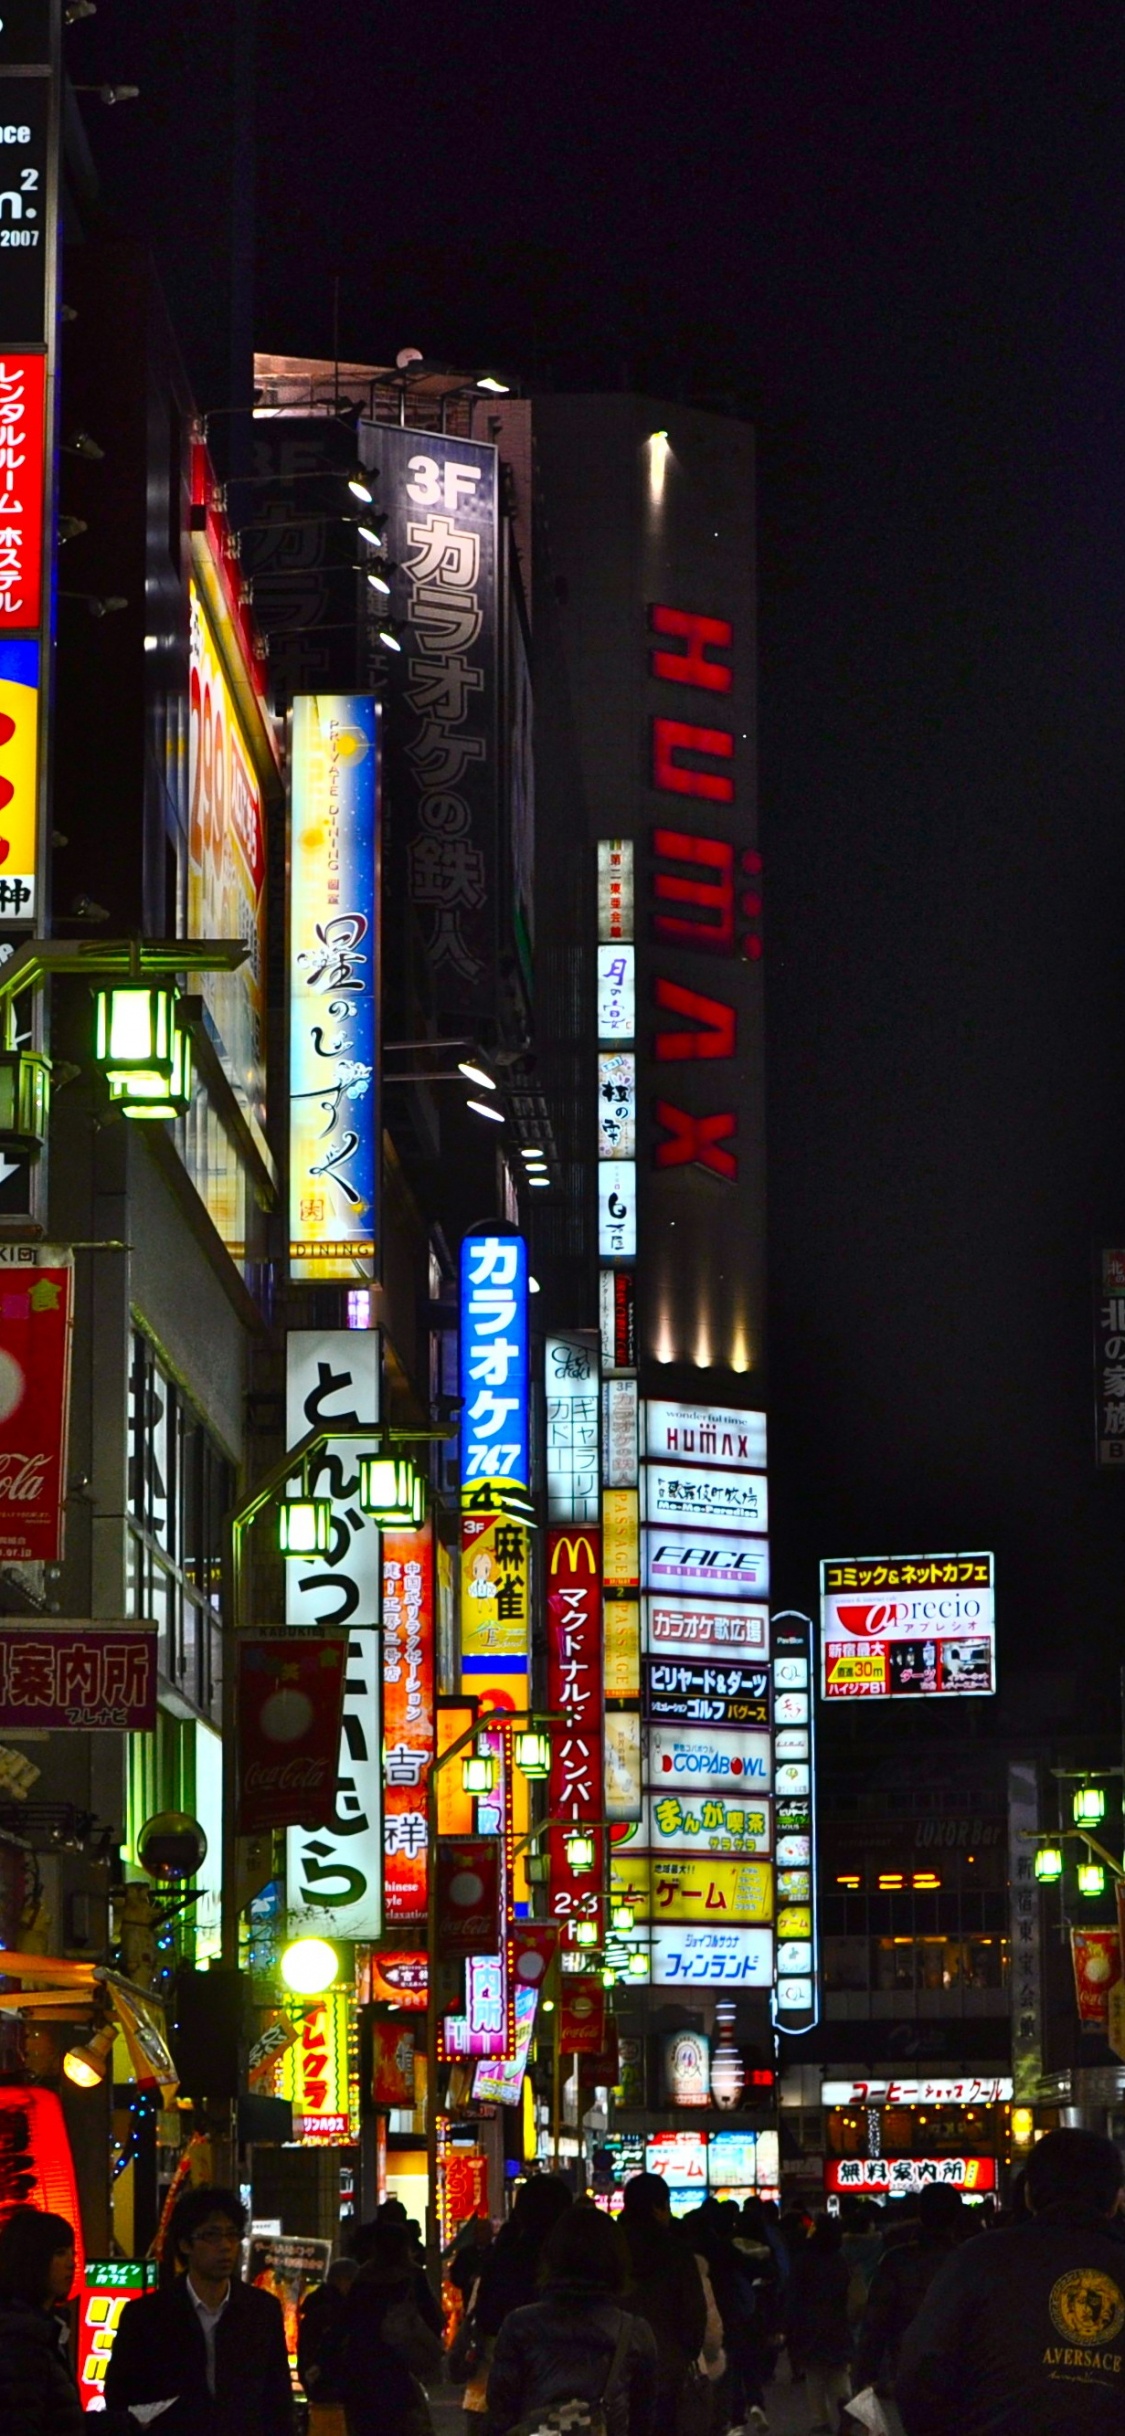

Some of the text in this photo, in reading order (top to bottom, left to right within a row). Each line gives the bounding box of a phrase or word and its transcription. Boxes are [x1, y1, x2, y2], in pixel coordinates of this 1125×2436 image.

[406, 454, 482, 511] 3F
[400, 513, 486, 986] カラオケの鉄人
[295, 1242, 369, 1258] DINING
[467, 1235, 520, 1441] カラオケ
[465, 1443, 522, 1476] 747
[463, 1520, 485, 1534] 3F
[493, 1523, 525, 1620] 麻雀
[652, 1545, 765, 1572] FACE
[828, 1563, 988, 1587] コミック&ネットカフェ
[654, 1612, 762, 1643] カラオケ歌広場
[865, 1593, 981, 1633] aprecio
[904, 1620, 978, 1633] アプレシオ
[559, 1588, 591, 1728] マクドナルド
[0, 1642, 149, 1707] 案内所
[651, 1666, 768, 1698] ビリヤード&ダーツ
[686, 1698, 726, 1720] ゴルフ
[653, 1797, 766, 1837] まんが喫茶
[656, 1876, 728, 1910] ゲーム
[664, 1953, 760, 1979] フィンランド
[849, 2080, 919, 2104] コーヒー
[968, 2078, 1003, 2102] クール
[650, 2158, 705, 2178] ゲーム
[837, 2157, 967, 2187] 無料案内所
